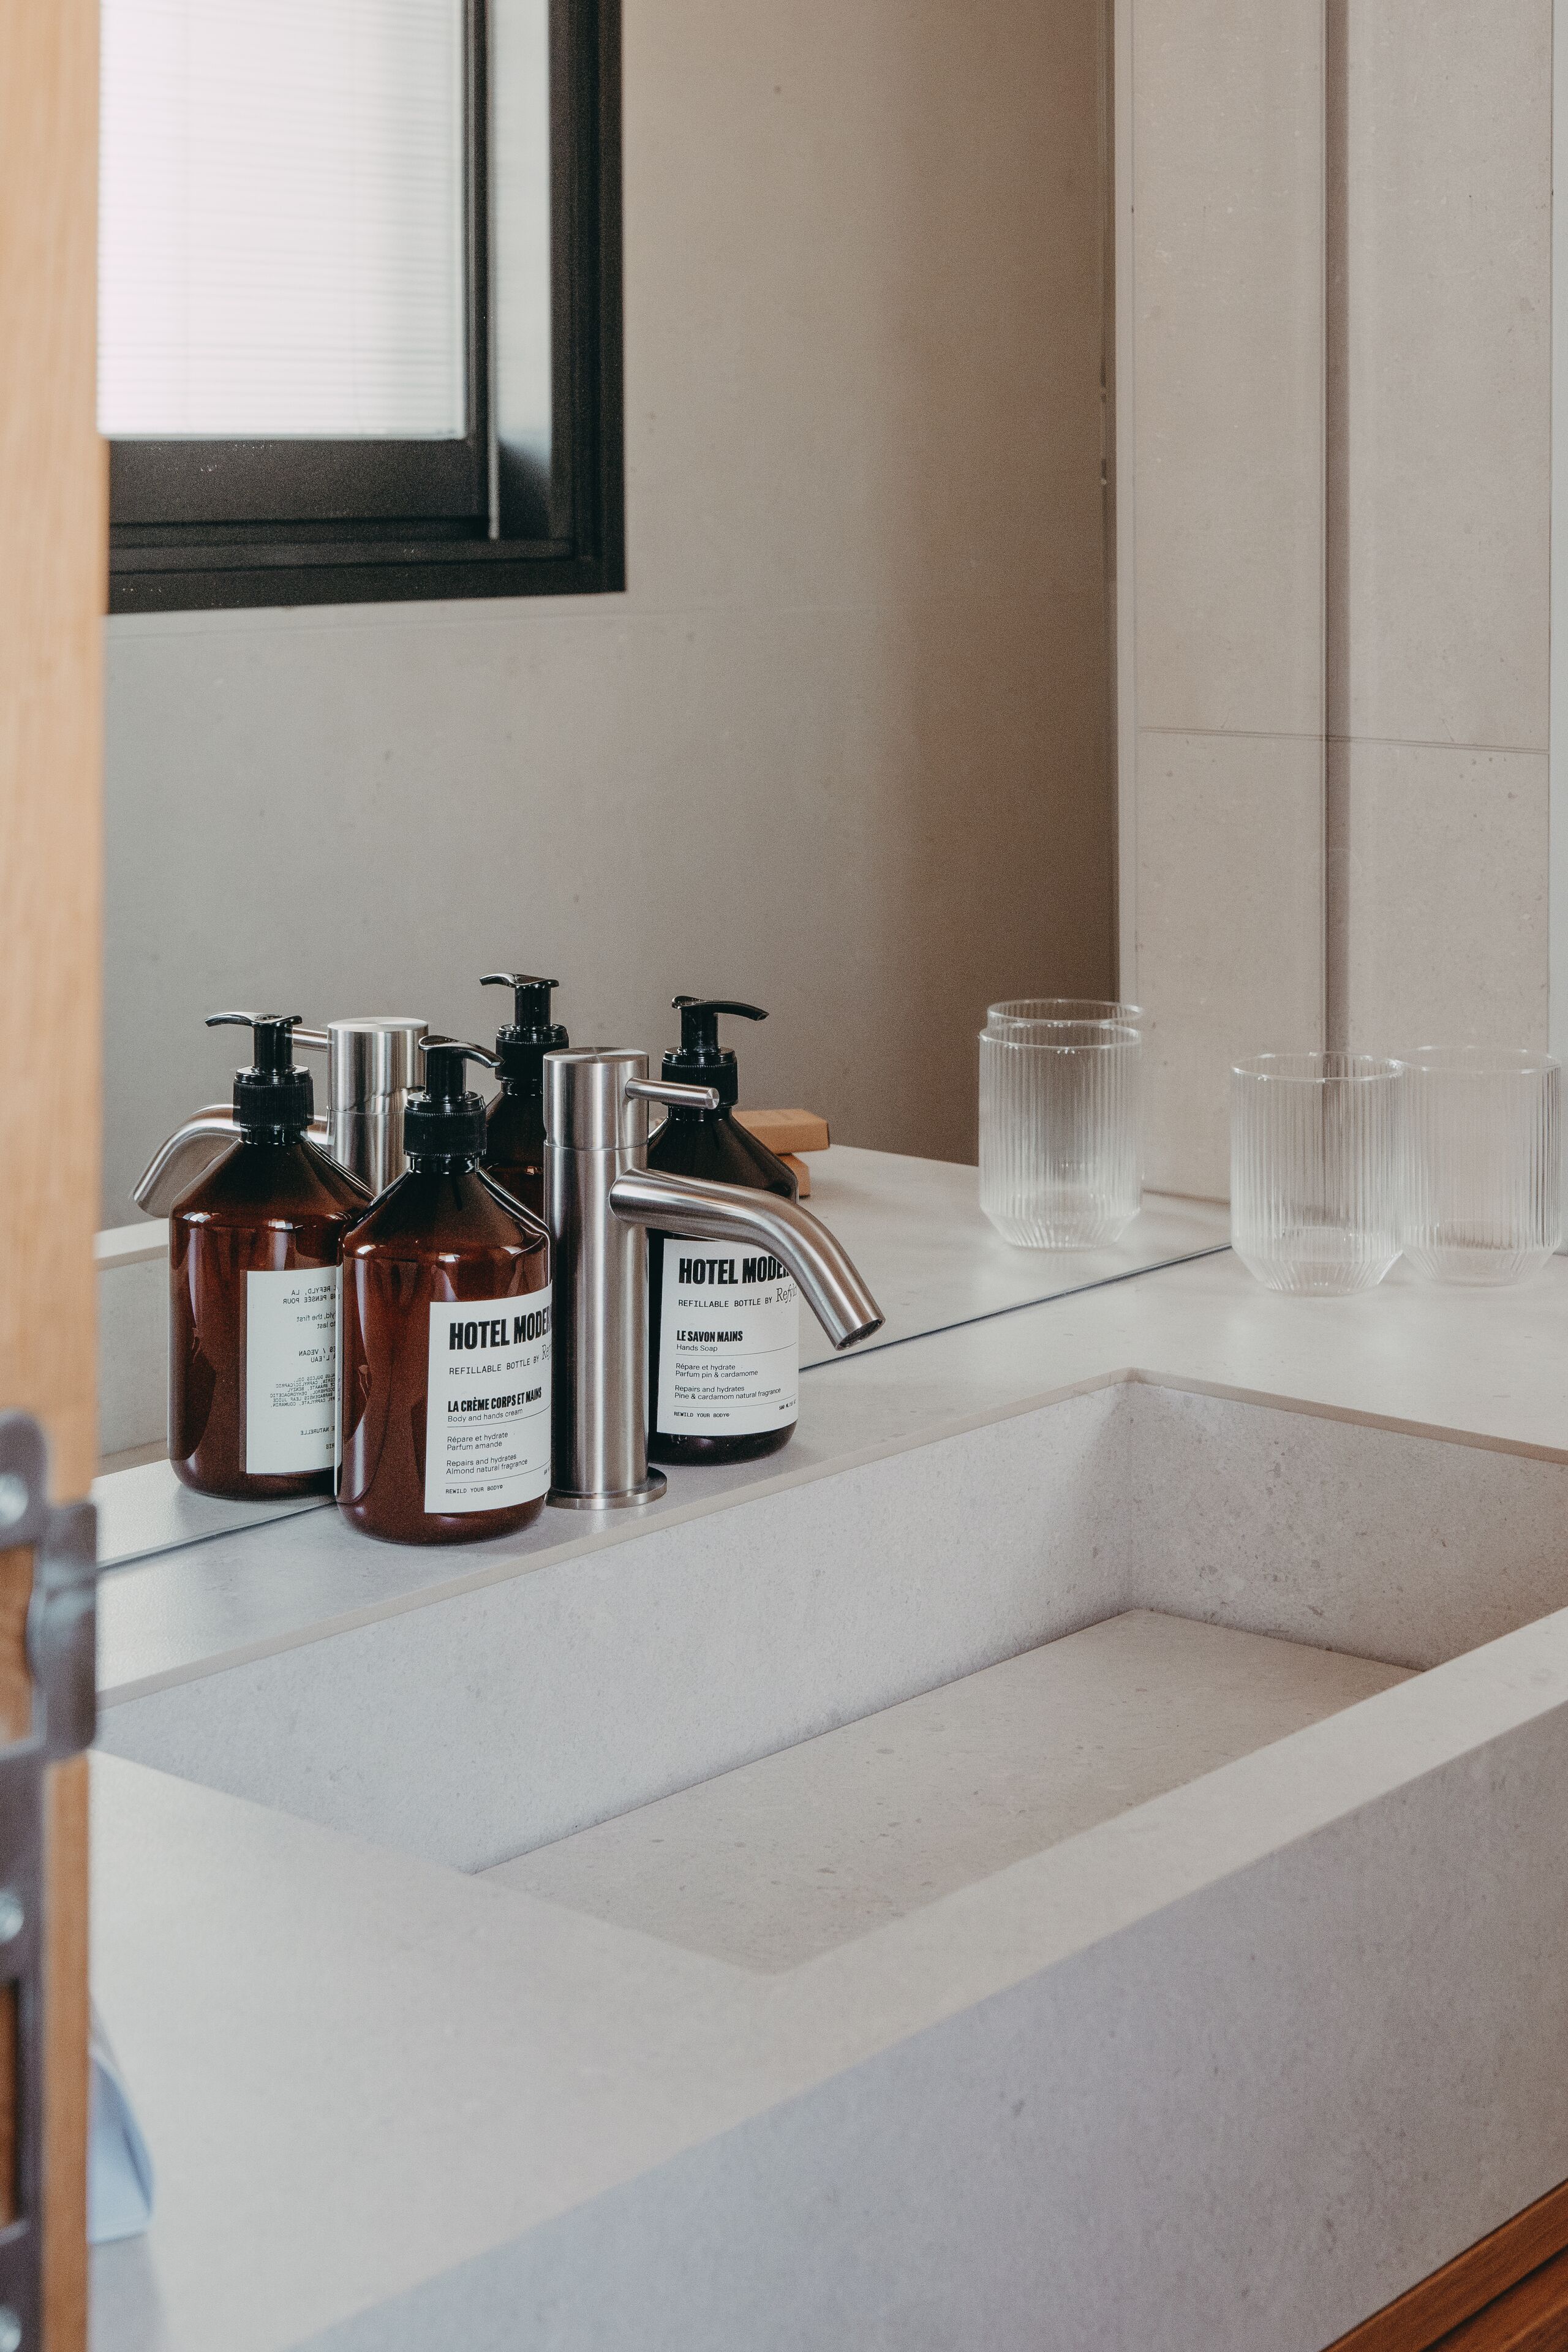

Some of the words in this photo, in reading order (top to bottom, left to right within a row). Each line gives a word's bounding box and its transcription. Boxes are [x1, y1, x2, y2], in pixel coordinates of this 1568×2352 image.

[678, 1257, 739, 1285] HOTEL
[678, 1299, 729, 1308] REFILLABLE
[734, 1298, 761, 1307] BOTTLE
[449, 1319, 510, 1351] HOTEL
[513, 1303, 552, 1344] MODER
[676, 1330, 687, 1341] LE
[687, 1330, 715, 1342] SAVON
[717, 1330, 743, 1342] MAINS
[449, 1364, 502, 1375] REFILLABLE
[507, 1358, 530, 1370] BOTTLE
[533, 1355, 539, 1364] BY
[758, 1388, 781, 1397] fragrance
[448, 1401, 459, 1412] LA
[461, 1396, 489, 1412] CRÈME
[491, 1394, 516, 1409] CORPS
[517, 1392, 525, 1405] ET
[526, 1386, 542, 1403] MAINS
[505, 1408, 523, 1417] cream
[447, 1436, 473, 1446] Répare
[484, 1432, 508, 1441] hydrate
[475, 1441, 502, 1449] amande
[491, 1453, 517, 1464] hydrates
[501, 1459, 528, 1469] fragrance
